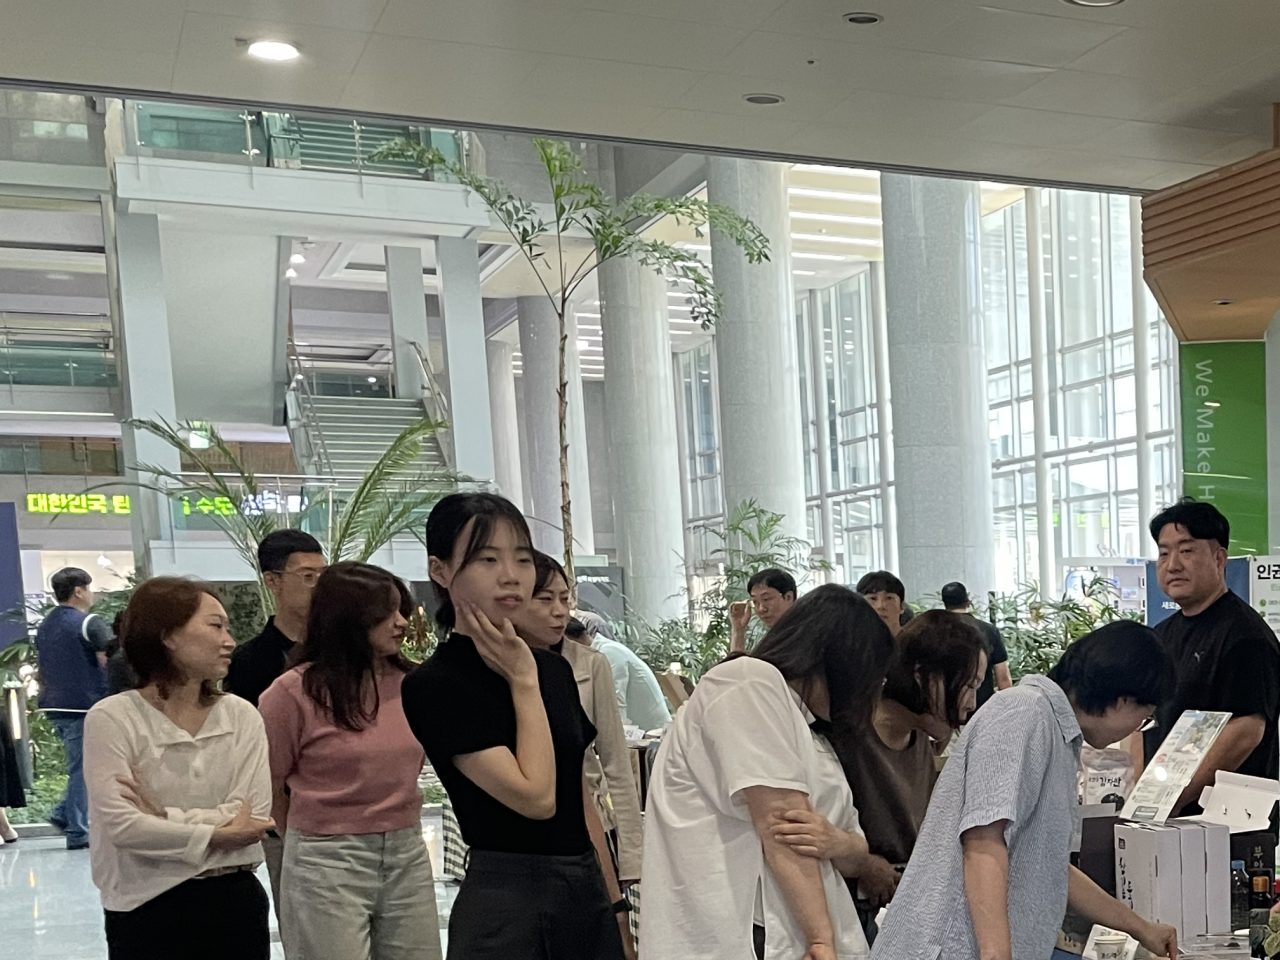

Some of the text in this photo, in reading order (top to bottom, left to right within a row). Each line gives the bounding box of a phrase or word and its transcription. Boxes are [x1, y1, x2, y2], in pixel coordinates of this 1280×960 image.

[1195, 359, 1213, 397] We
[1196, 406, 1215, 474] Make
[26, 494, 107, 513] 대한민국
